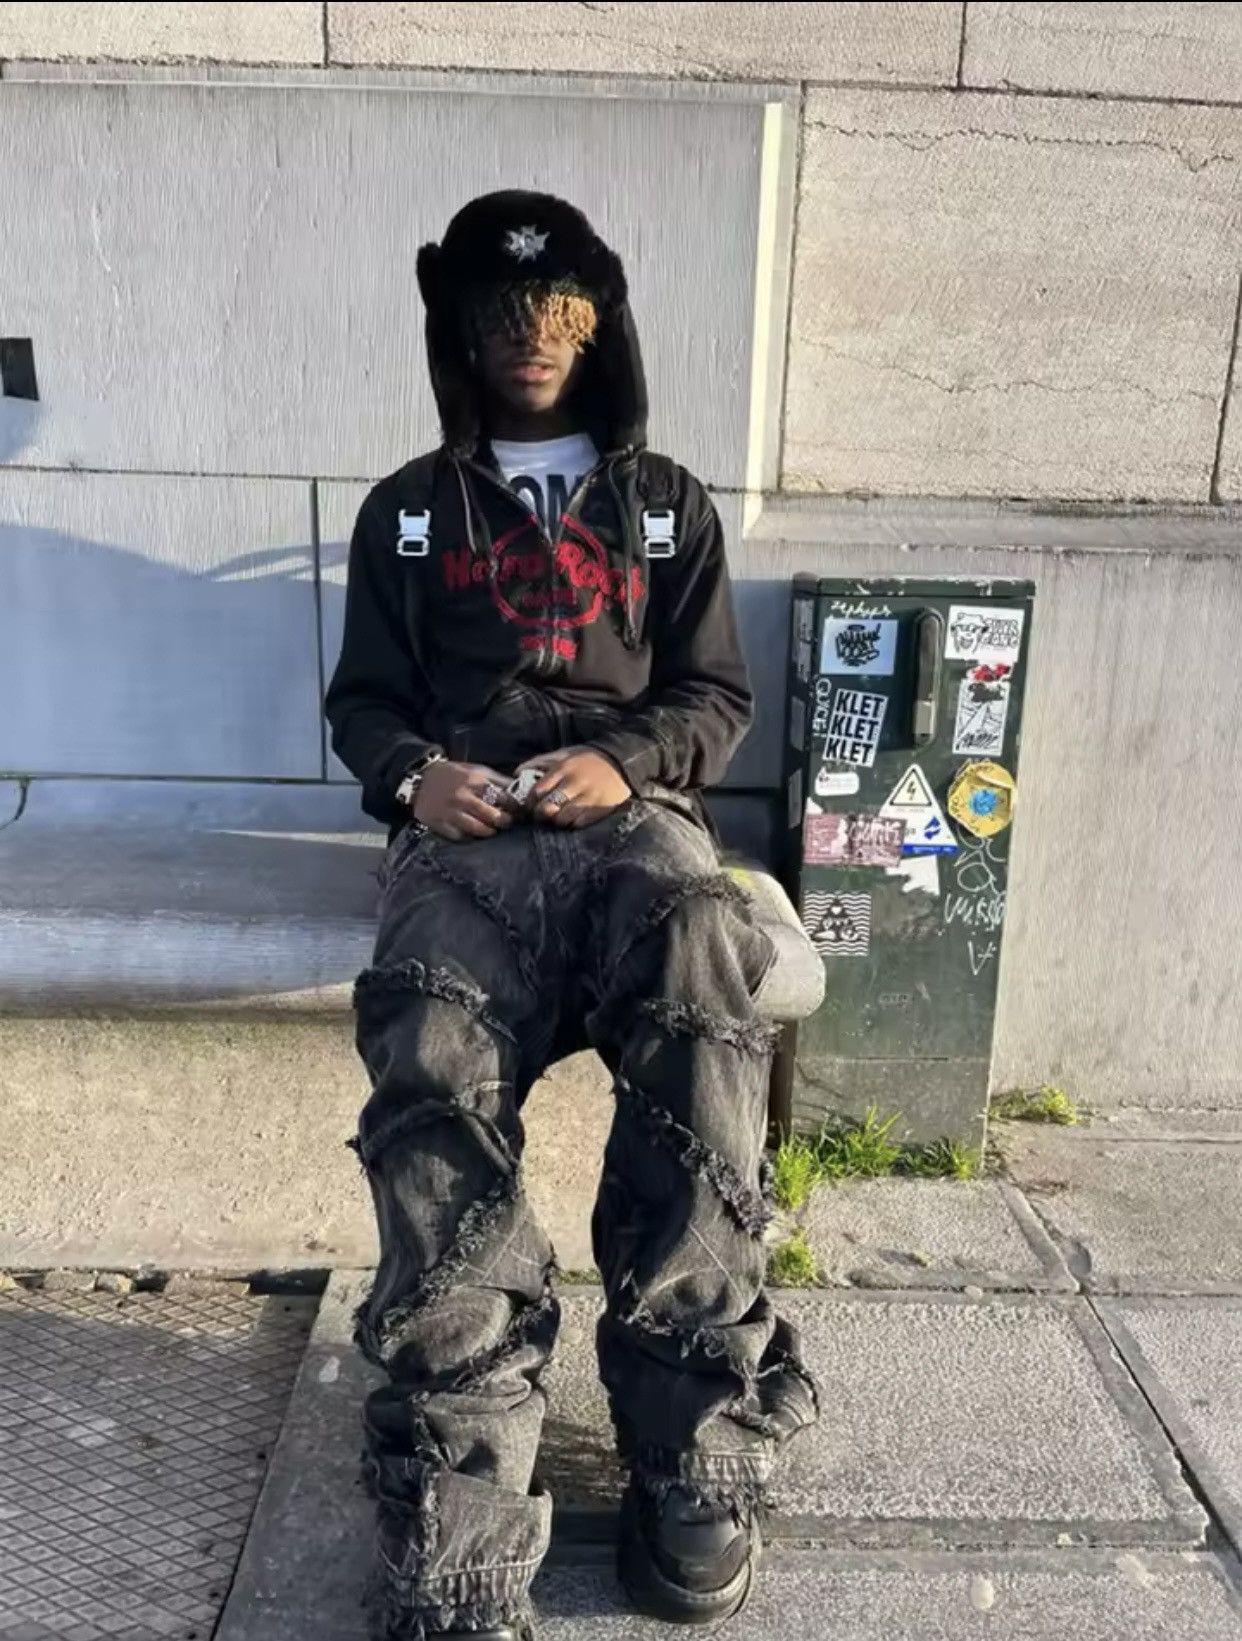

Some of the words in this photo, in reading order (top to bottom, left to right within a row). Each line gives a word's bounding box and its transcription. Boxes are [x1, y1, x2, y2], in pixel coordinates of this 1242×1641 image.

[835, 691, 884, 718] KLET
[830, 715, 879, 741] KLET
[824, 738, 873, 765] KLET
